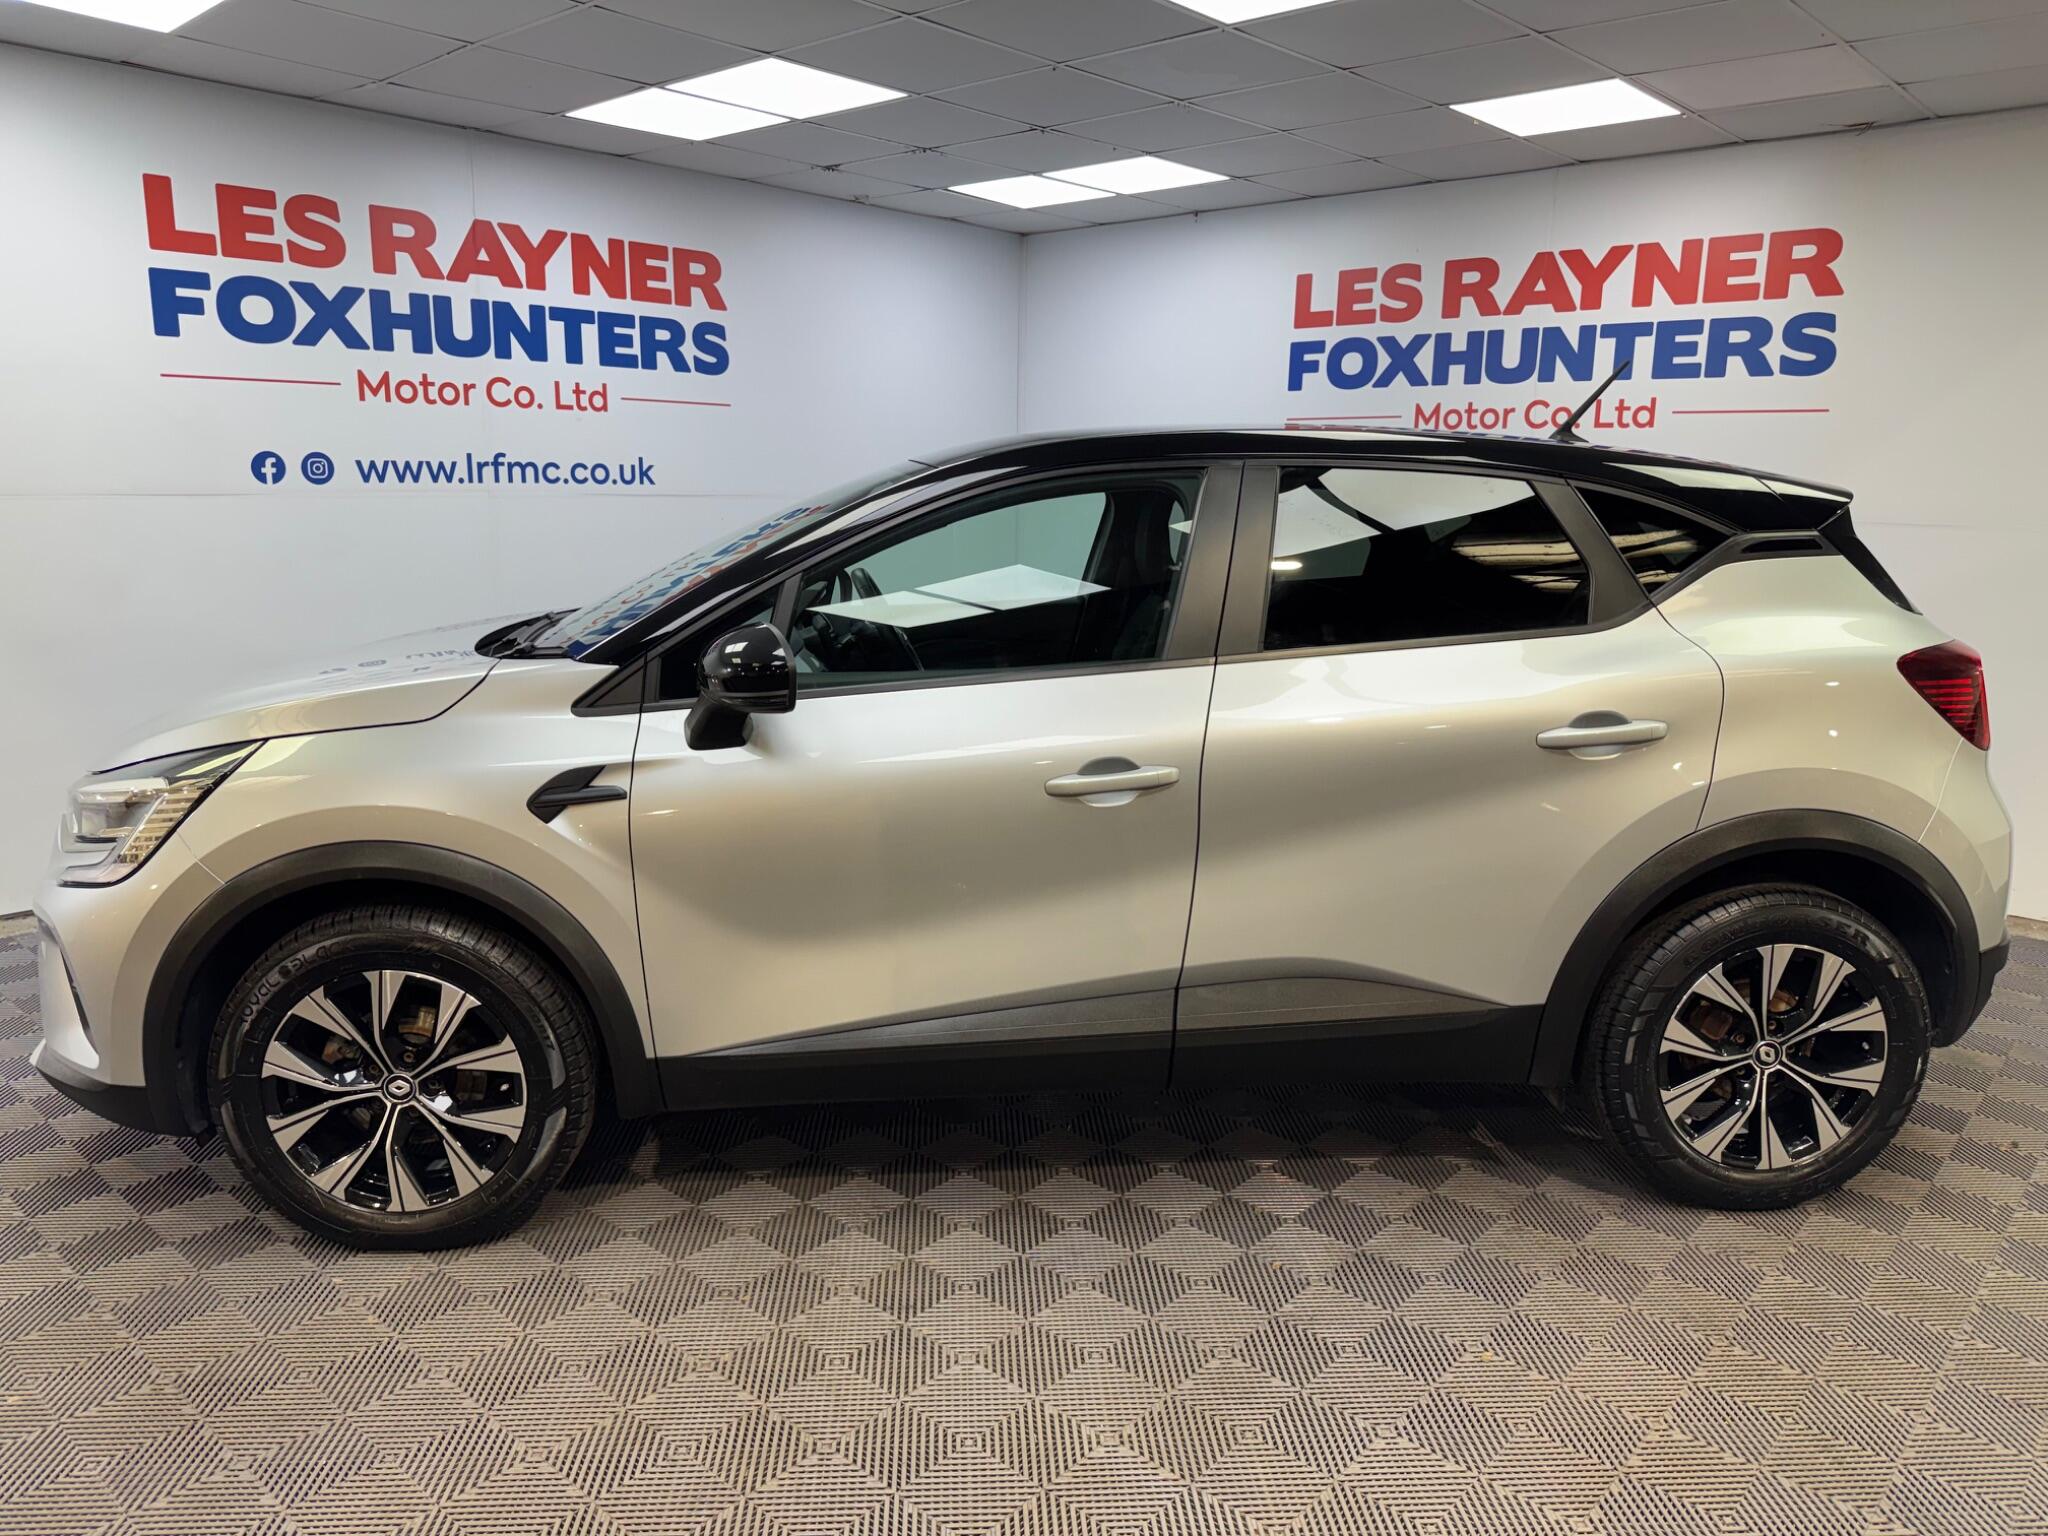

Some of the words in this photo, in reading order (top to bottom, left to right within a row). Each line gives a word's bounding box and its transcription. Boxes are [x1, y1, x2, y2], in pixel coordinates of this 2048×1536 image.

[143, 174, 346, 269] LES
[369, 204, 727, 311] RAYNER
[1293, 264, 1422, 329] LES
[1442, 227, 1844, 319] RAYNER
[149, 267, 730, 375] FOXHUNTERS
[1287, 312, 1837, 391] FOXHUNTERS
[357, 370, 476, 406] Motor
[486, 376, 543, 410] Co.
[554, 381, 608, 412] Ltd
[1414, 403, 1515, 431] Motor
[1593, 397, 1657, 430] Ltd
[355, 451, 655, 486] www.lrfmc.co.uk
